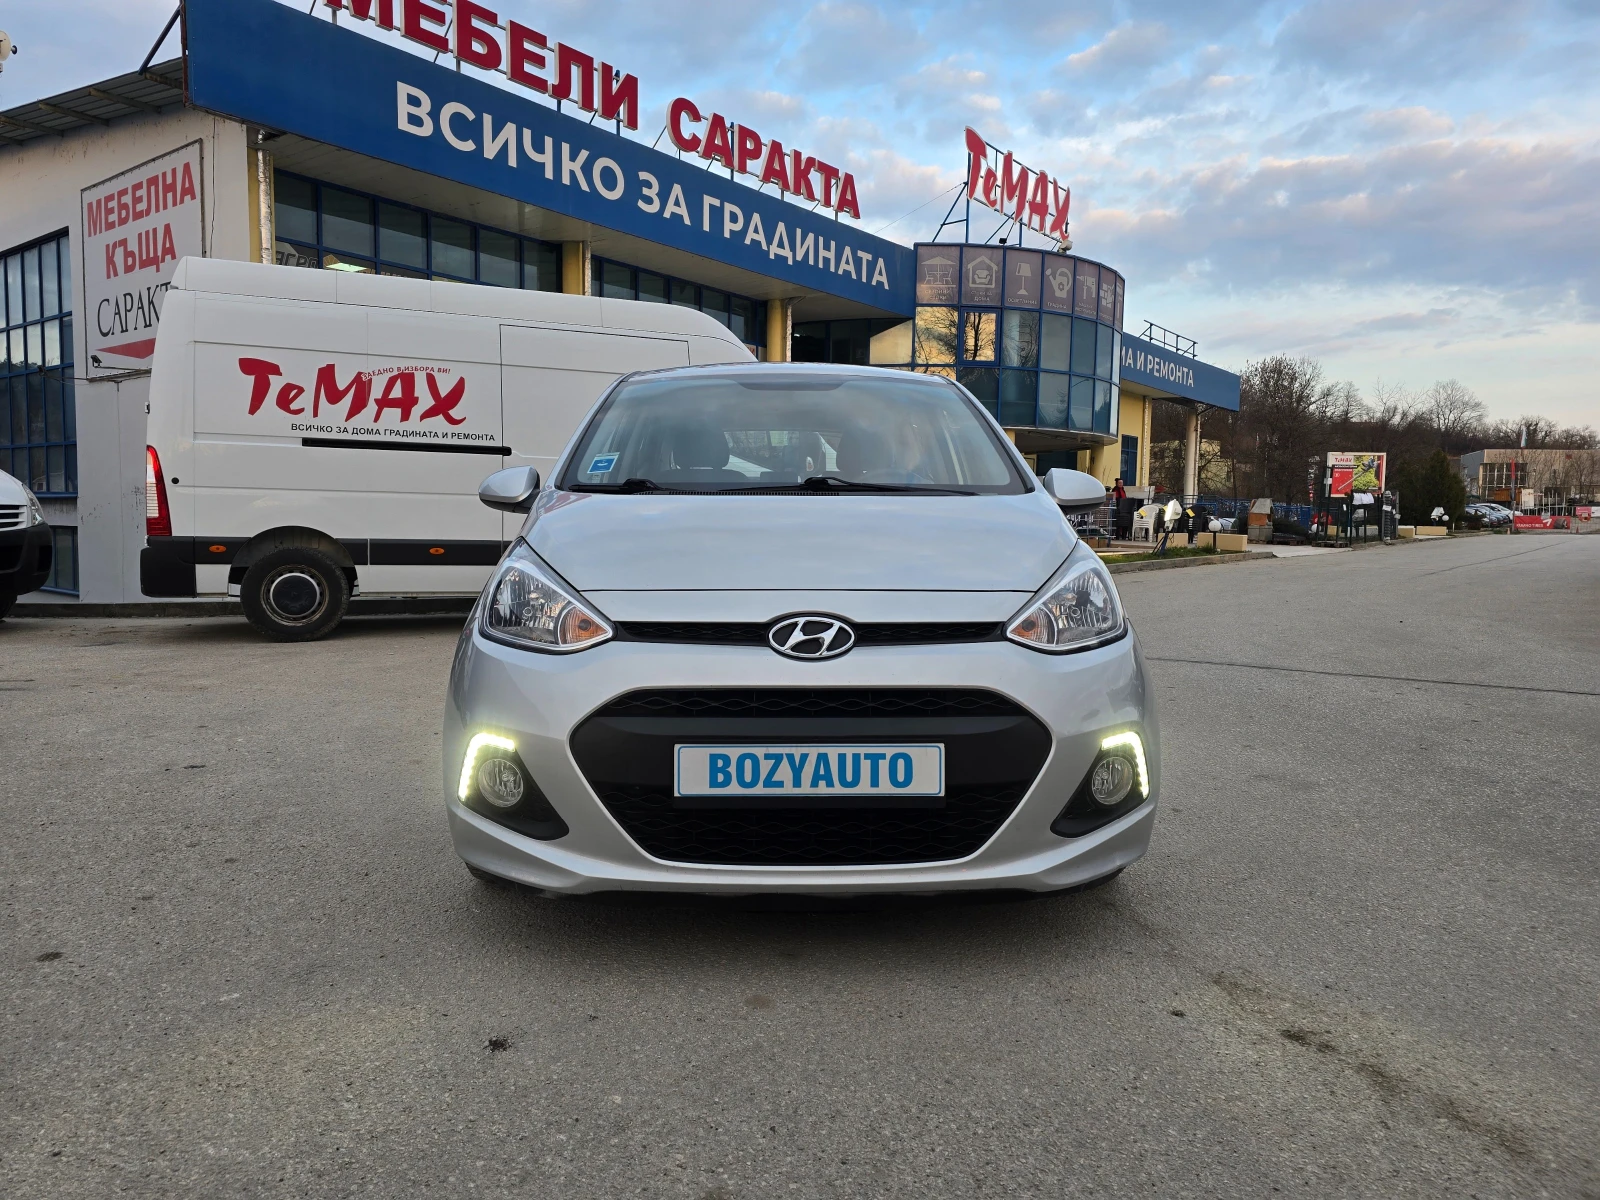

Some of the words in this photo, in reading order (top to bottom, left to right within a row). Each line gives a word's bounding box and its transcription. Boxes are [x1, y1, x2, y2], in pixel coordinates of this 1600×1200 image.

[322, 0, 639, 131] ЕБЕЛИ
[666, 97, 861, 219] САРАКТА
[86, 161, 197, 238] МЕБЕЛНА
[396, 80, 625, 201] ВСИЧКО
[637, 171, 691, 226] ЗА
[702, 194, 890, 290] ГРАДИНАТА
[105, 222, 177, 279] КЪЩА
[404, 365, 436, 373] ИЗБОРА
[1136, 350, 1145, 372] И
[1147, 354, 1195, 388] РЕМОНТА
[290, 423, 333, 434] ВСИЧКО
[335, 425, 350, 434] ЗА
[351, 425, 382, 436] ДОМА
[383, 428, 440, 440] ГРАДИНАТА
[441, 431, 449, 439] И
[450, 432, 496, 442] РЕМОНТА
[708, 752, 914, 789] BOZYAUTO
